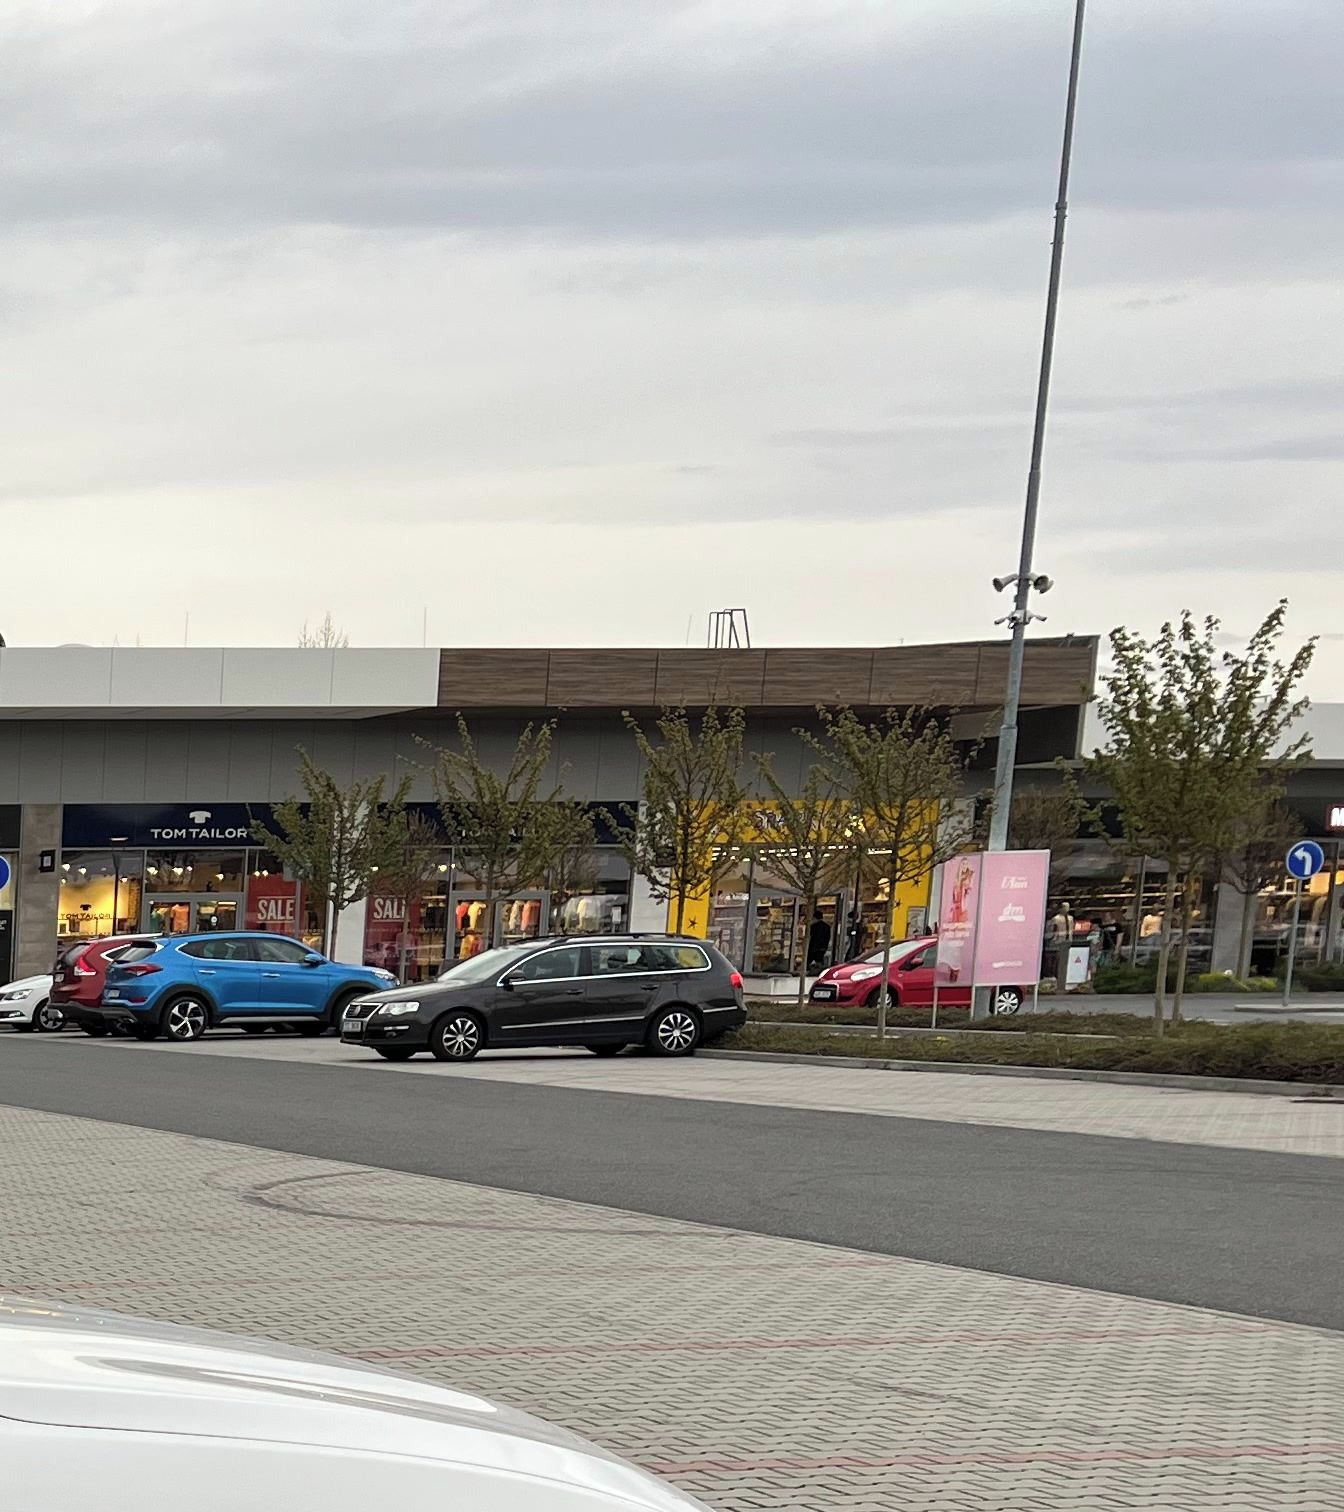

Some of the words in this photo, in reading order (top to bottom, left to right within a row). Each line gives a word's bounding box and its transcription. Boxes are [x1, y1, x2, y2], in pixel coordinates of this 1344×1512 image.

[150, 828, 187, 840] TOM
[187, 828, 248, 840] TAILOR
[256, 899, 295, 921] SALE
